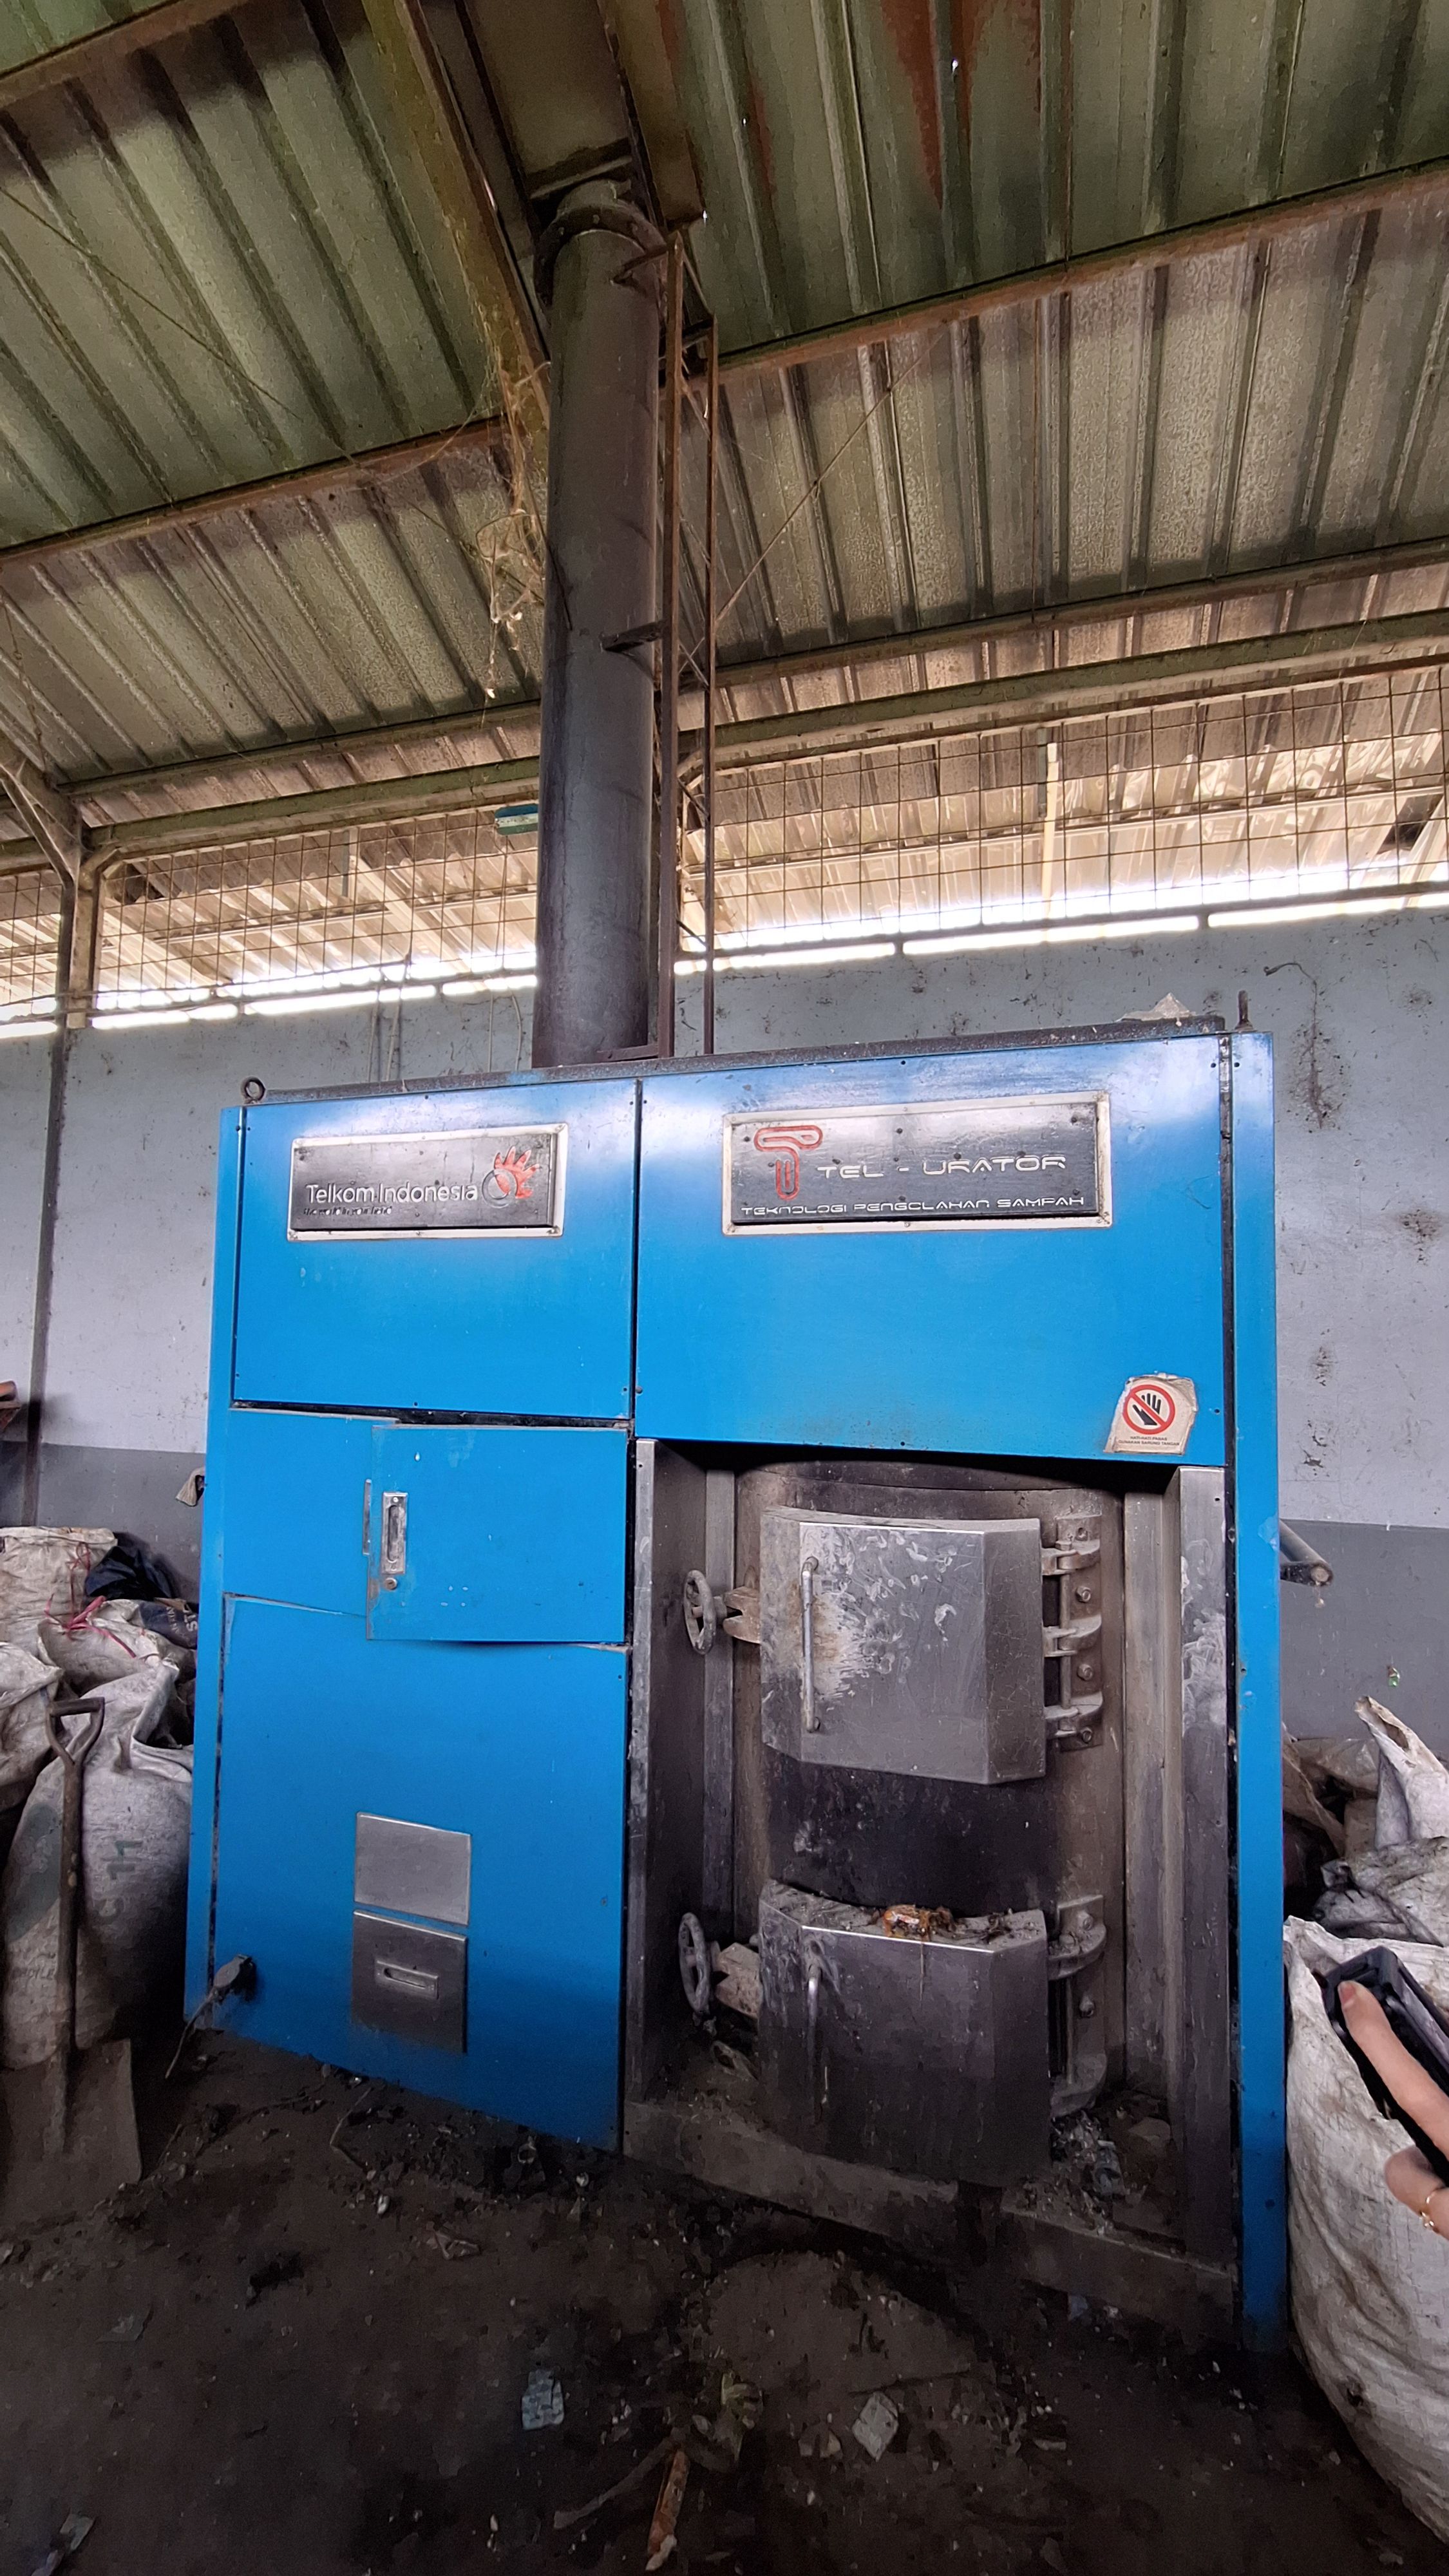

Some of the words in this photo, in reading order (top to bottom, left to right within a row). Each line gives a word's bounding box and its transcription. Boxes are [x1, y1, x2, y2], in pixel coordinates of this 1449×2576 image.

[817, 1164, 884, 1179] TEL
[923, 1155, 1066, 1175] URATOR
[305, 1182, 375, 1204] Telkom
[379, 1181, 478, 1203] Indonesia
[741, 1204, 847, 1216] TEKNOLOGI
[997, 1197, 1084, 1208] SAMPAH
